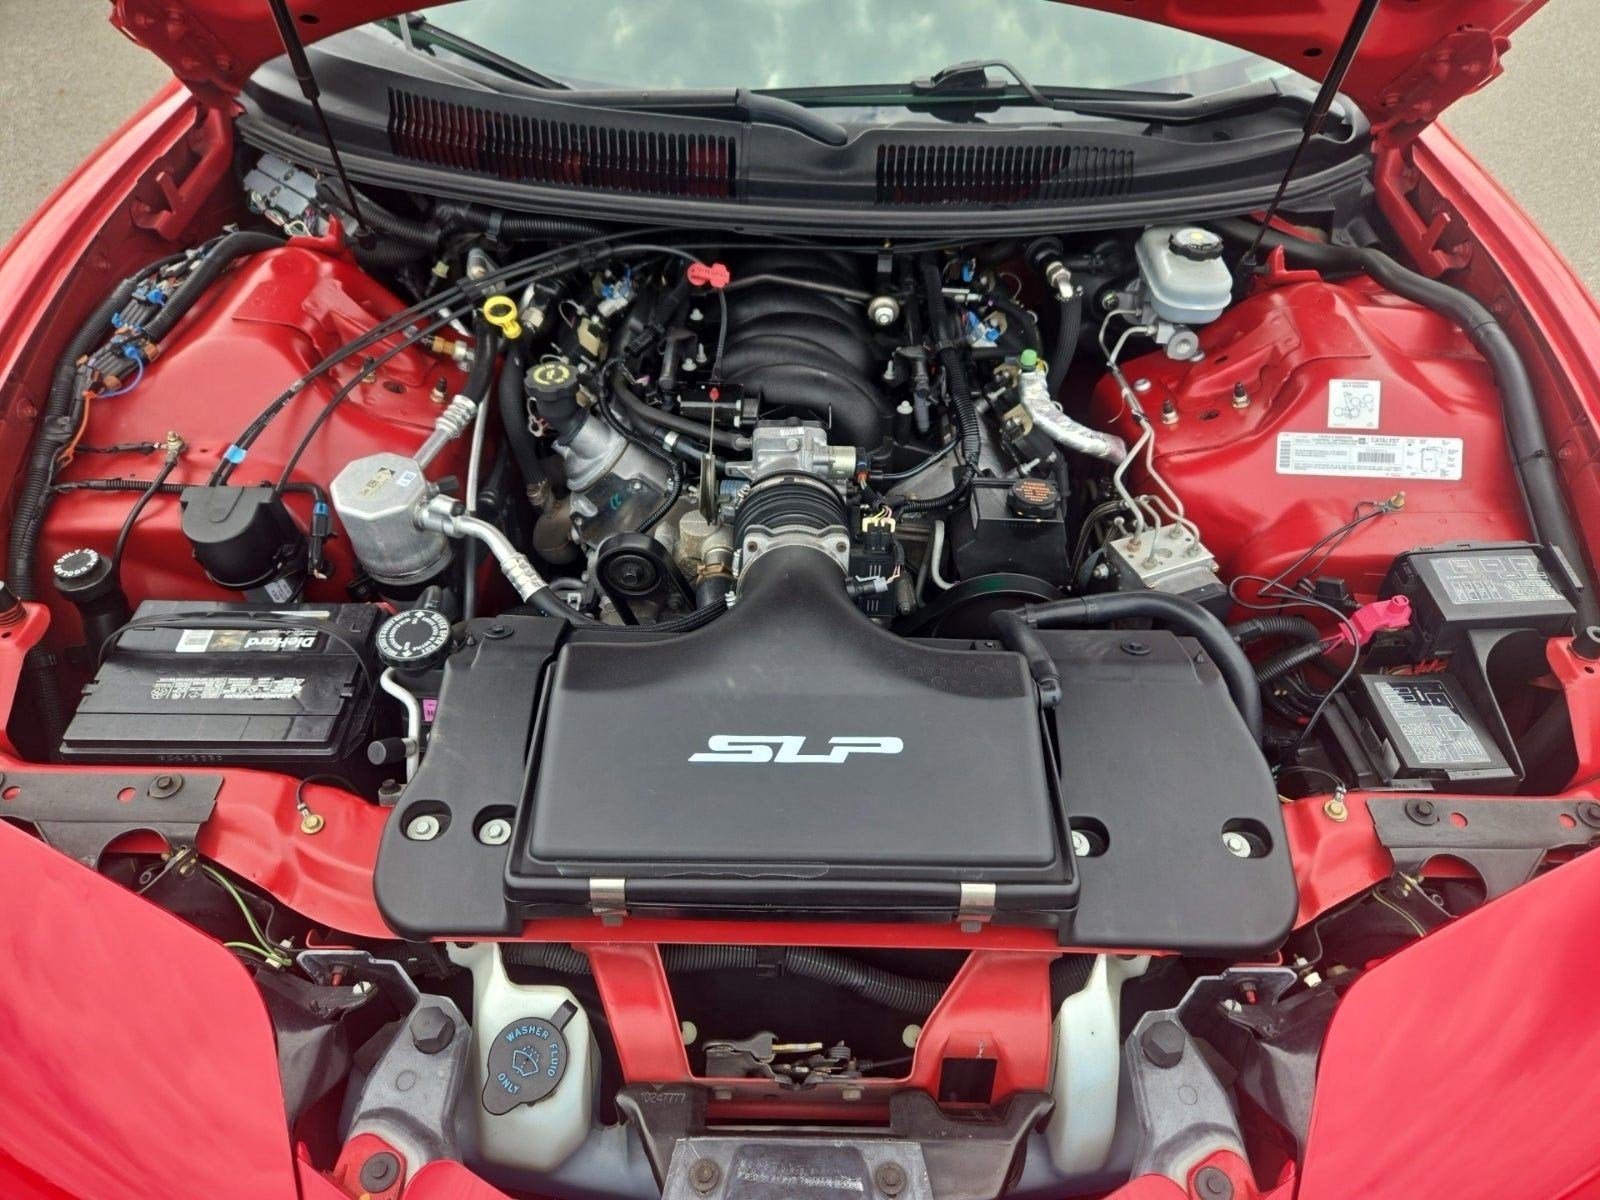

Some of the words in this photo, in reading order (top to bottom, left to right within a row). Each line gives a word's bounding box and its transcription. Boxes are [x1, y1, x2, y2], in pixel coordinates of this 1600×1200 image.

[246, 636, 315, 648] DieHard
[688, 735, 904, 763] SLP
[505, 1025, 549, 1042] WASHER
[547, 1043, 559, 1077] FLUID
[498, 1072, 520, 1094] ONLY
[640, 1090, 686, 1104] 10247777
